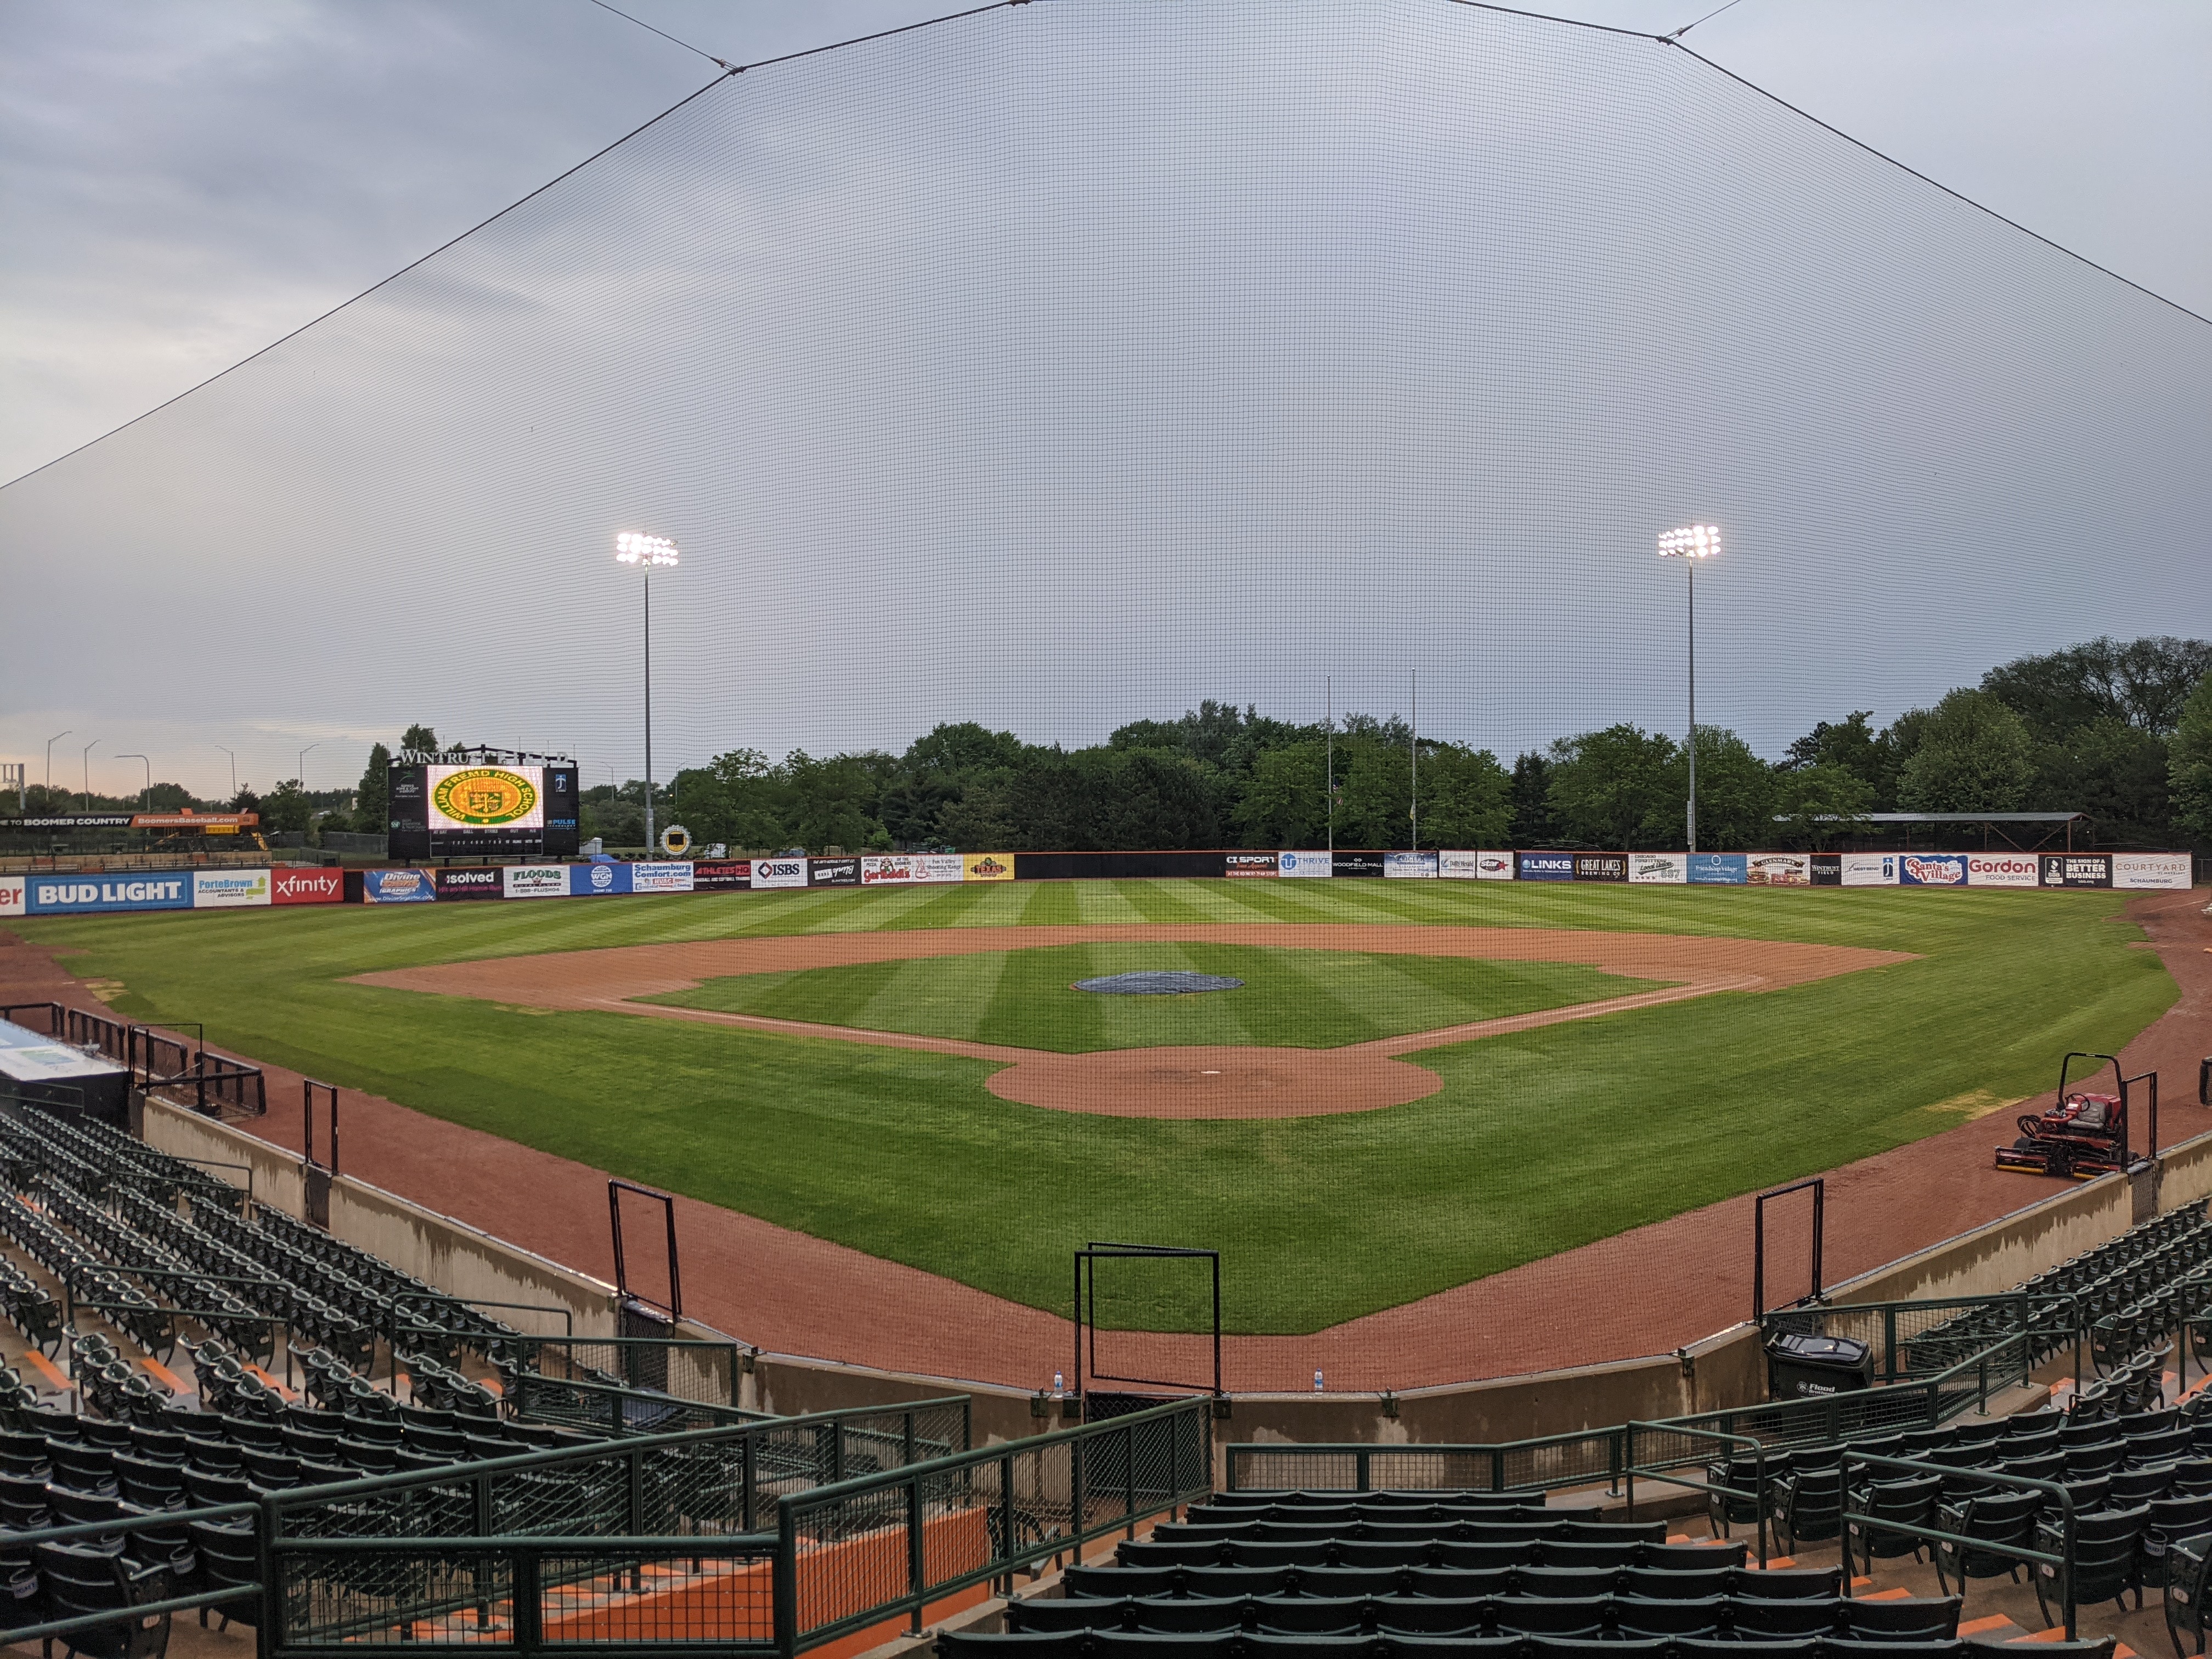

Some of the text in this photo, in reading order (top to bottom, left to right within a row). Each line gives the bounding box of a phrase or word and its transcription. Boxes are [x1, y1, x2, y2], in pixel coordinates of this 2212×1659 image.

[401, 749, 568, 765] WINTRUST FIELD
[437, 770, 533, 820] WILLIAM FREMD HIGH SCHOOL
[695, 866, 750, 874] ATHLETES HQ
[772, 864, 799, 875] ISBS
[1531, 860, 1572, 869] LINKS
[1581, 859, 1621, 871] GREAT LAKES
[1907, 859, 1949, 877] Santa's
[1969, 860, 2036, 874] Gordon
[2066, 864, 2106, 872] BETTER
[2115, 863, 2186, 871] COURTYARD
[446, 872, 495, 884] isolved
[514, 870, 561, 881] FLOODS
[1660, 869, 1680, 878] 597
[1921, 870, 1961, 882] Village
[199, 879, 253, 889] PorteBrown
[276, 876, 338, 897] xfinity
[38, 882, 182, 904] BUD LIGHT
[1809, 1383, 1836, 1393] Flood
